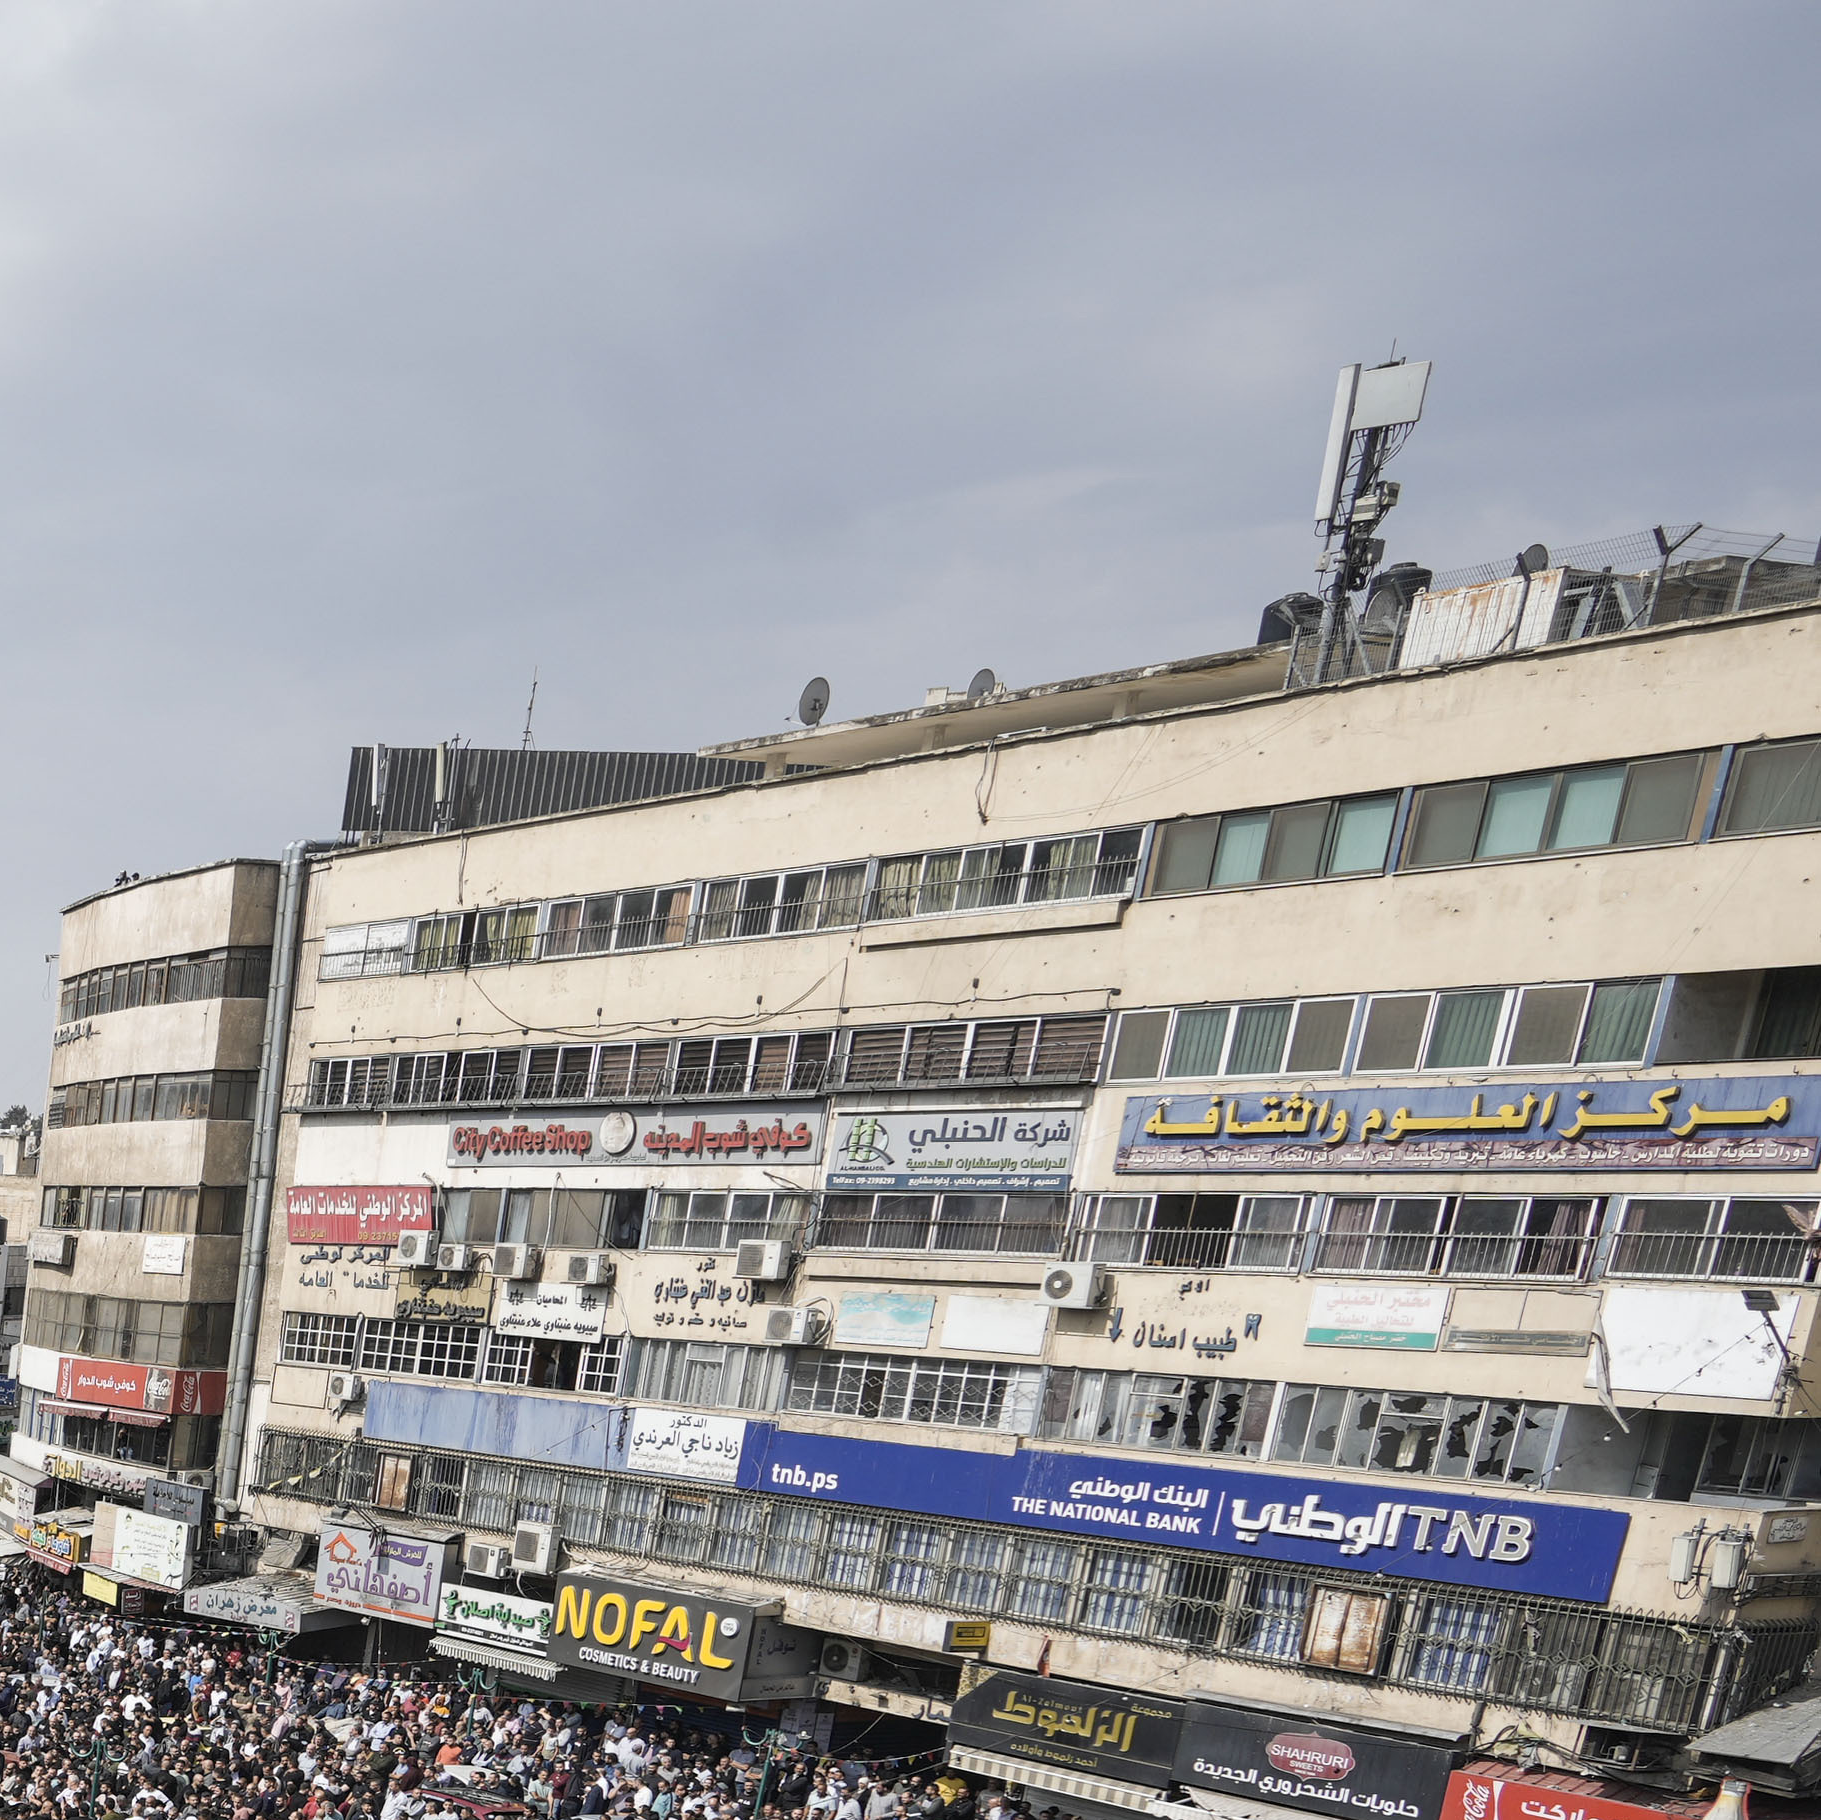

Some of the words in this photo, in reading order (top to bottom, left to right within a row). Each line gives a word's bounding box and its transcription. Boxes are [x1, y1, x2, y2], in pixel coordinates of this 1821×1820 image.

[1144, 1092, 1350, 1145] والثقافة
[1360, 1091, 1560, 1143] العلوم
[1558, 1086, 1792, 1140] مركز
[453, 1126, 488, 1161] City
[488, 1125, 544, 1152] Coffee
[546, 1124, 593, 1157] Shop
[749, 1119, 812, 1153] كوفي
[908, 1116, 1008, 1153] الحنبلي
[1014, 1118, 1071, 1148] شركة
[906, 1157, 953, 1171] الهندسية
[1020, 1157, 1067, 1170] للدراسات
[289, 1190, 316, 1216] العامة
[317, 1191, 357, 1216] للخدمات
[360, 1191, 395, 1228] الوطني
[396, 1191, 428, 1223] المركز
[1192, 1326, 1237, 1361] طبيب
[77, 1374, 96, 1386] الدوار
[95, 1376, 114, 1389] شوب
[113, 1379, 137, 1395] كوفي
[670, 1415, 709, 1429] الدكتور
[681, 1433, 713, 1459] ناجي
[715, 1436, 739, 1461] زياد
[772, 1463, 838, 1491] tnb.ps
[1069, 1476, 1151, 1503] الوطني
[1152, 1484, 1209, 1509] البنك
[1012, 1496, 1046, 1515] THE
[1049, 1500, 1142, 1528] NATIONAL
[1145, 1510, 1202, 1535] BANK
[1231, 1494, 1409, 1556] الوطني
[1408, 1504, 1536, 1562] TNB
[326, 1557, 433, 1607] أصفهاني
[243, 1601, 277, 1617] معرض
[554, 1585, 734, 1670] NOFAL
[579, 1647, 638, 1672] COSMETICS
[640, 1659, 649, 1673] &
[652, 1661, 701, 1684] BEAUTY
[992, 1690, 1138, 1752] الزلموط
[1130, 1703, 1173, 1719] مجموعة
[1075, 1755, 1099, 1768] أحمد
[1192, 1757, 1258, 1785] الجديدة
[1270, 1744, 1350, 1770] SHAHRURI
[1288, 1760, 1325, 1774] SWEETS
[1258, 1773, 1351, 1803] الشحروري
[1351, 1793, 1420, 1818] حلويات
